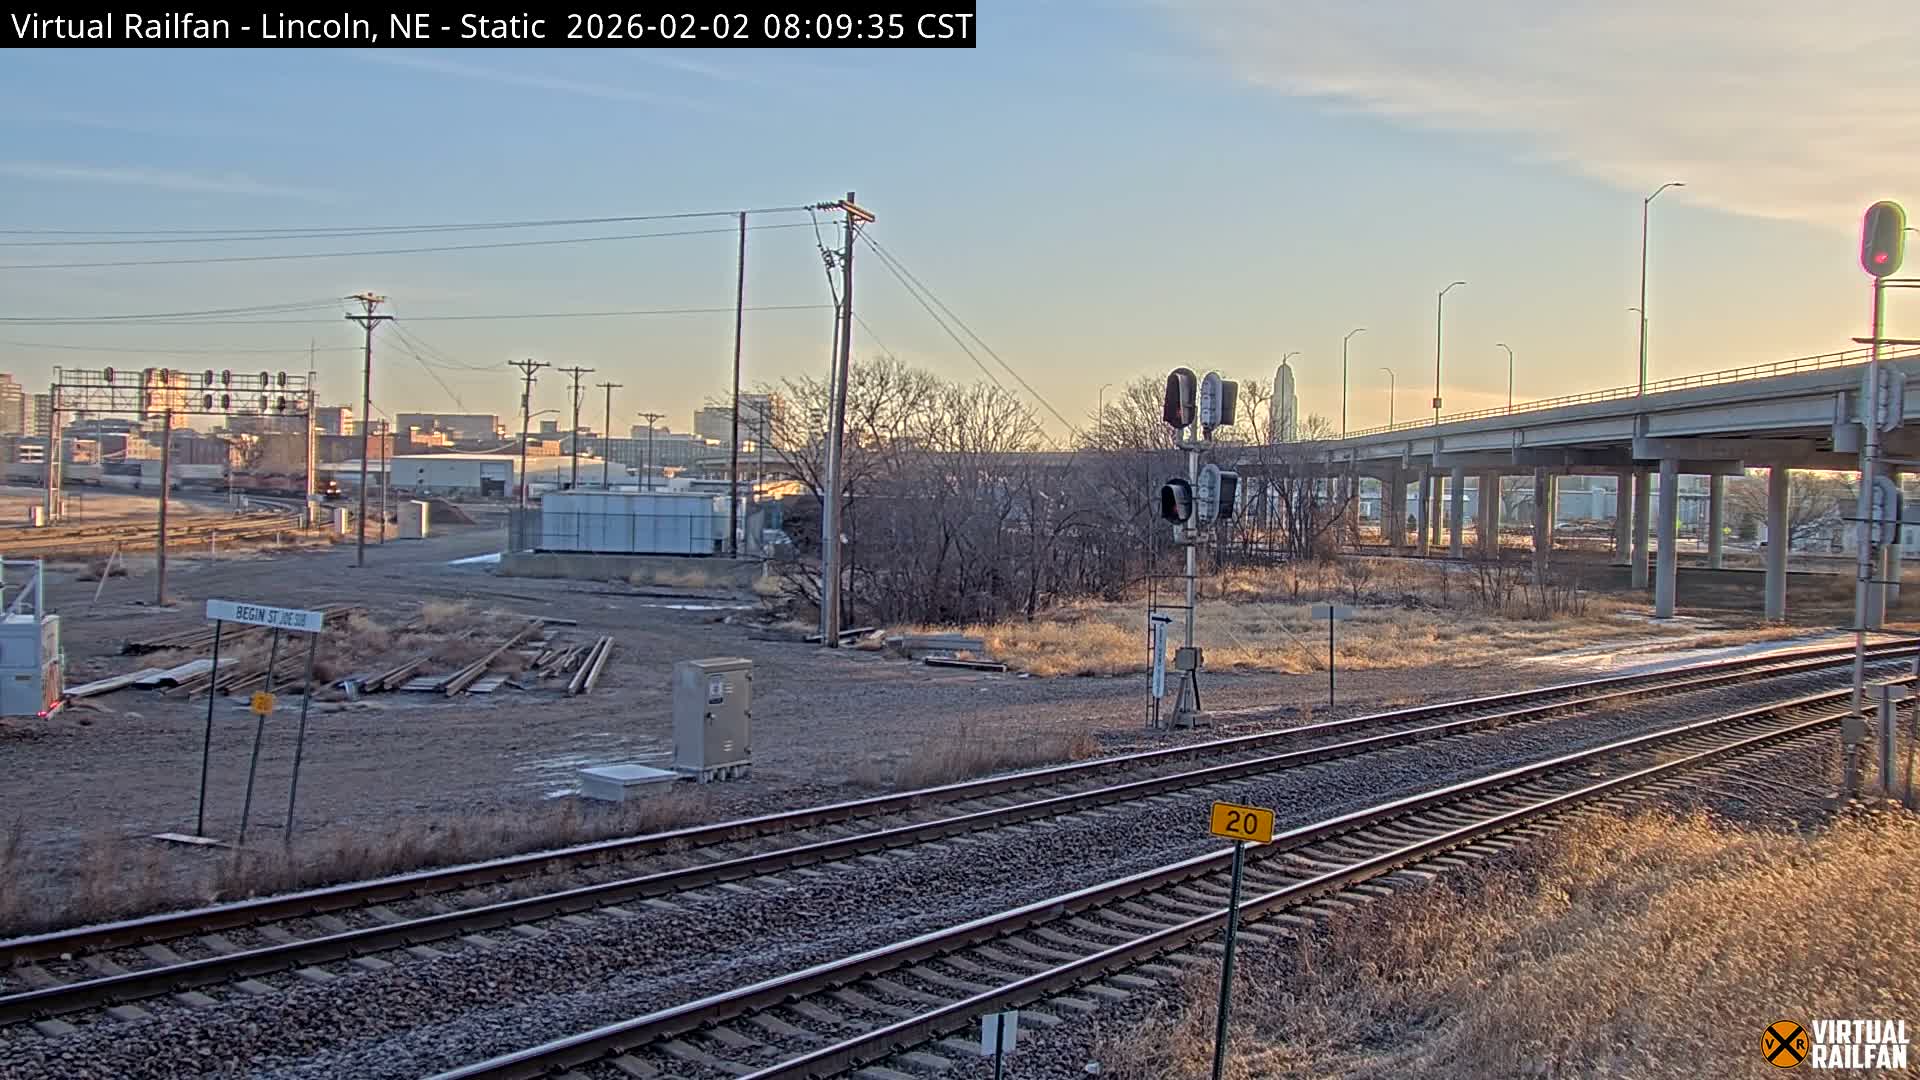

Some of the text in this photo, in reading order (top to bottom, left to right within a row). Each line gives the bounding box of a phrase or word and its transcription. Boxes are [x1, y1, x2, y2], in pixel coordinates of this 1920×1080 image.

[236, 606, 265, 622] BEGIN
[267, 610, 278, 624] ST
[1226, 810, 1258, 835] 20
